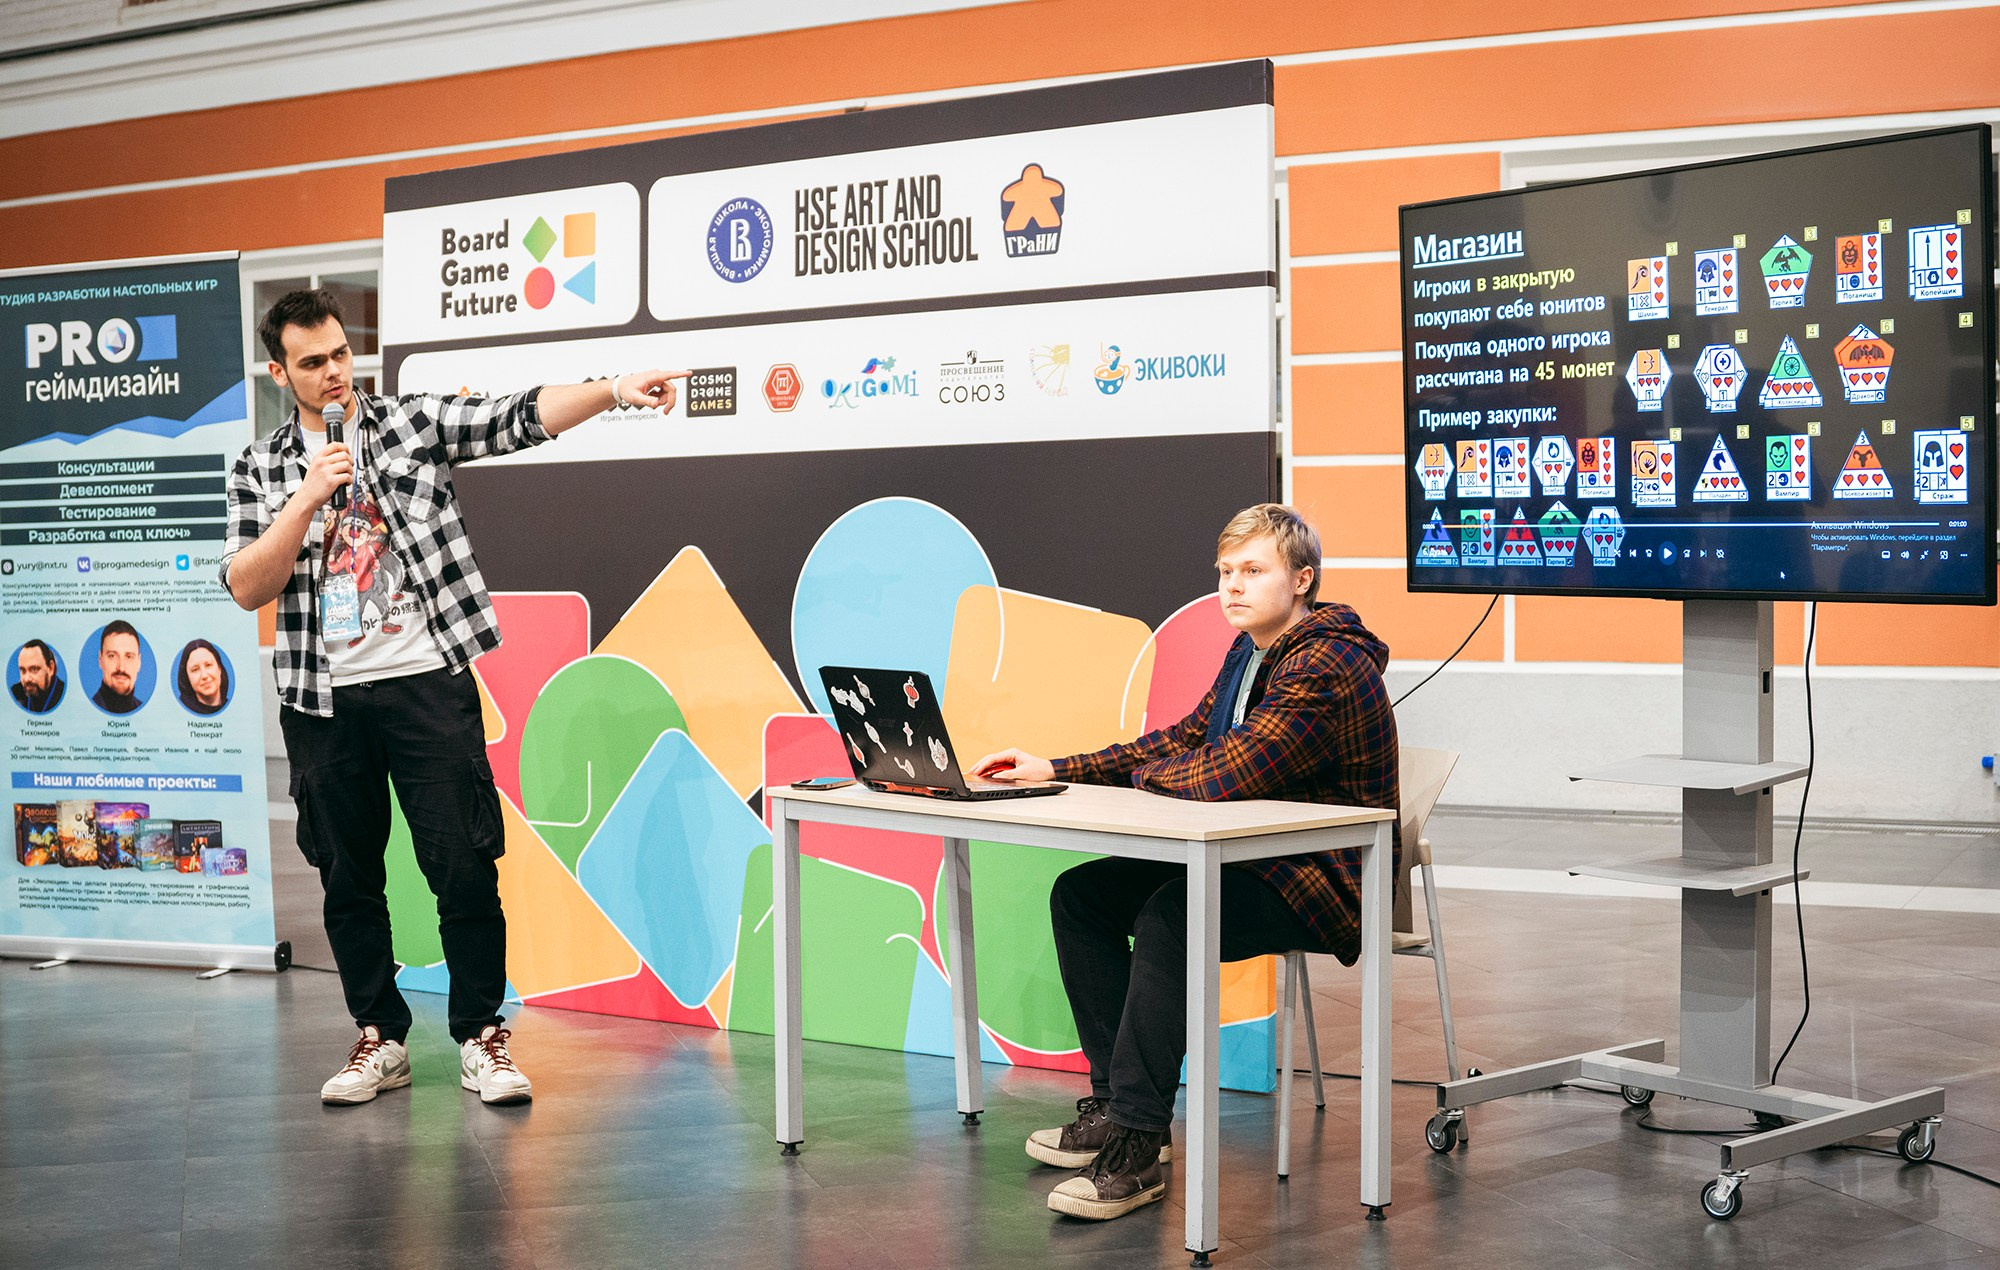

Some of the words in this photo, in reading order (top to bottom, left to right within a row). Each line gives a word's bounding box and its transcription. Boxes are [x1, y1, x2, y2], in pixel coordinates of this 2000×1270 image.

[795, 185, 839, 233] HSE
[843, 179, 889, 228] ART
[893, 173, 941, 223] AND
[714, 200, 749, 227] ШКОЛА
[441, 218, 510, 256] Board
[795, 226, 877, 277] DESIGN
[883, 216, 979, 269] SCHOOL
[1413, 230, 1524, 266] Магазин
[440, 258, 510, 287] Game
[38, 287, 110, 303] РАЗРАБОТКИ
[113, 280, 193, 297] НАСТОЛЬНЫХ
[195, 279, 218, 291] ИГР
[1413, 279, 1471, 301] Игроки
[1476, 277, 1487, 292] в
[1492, 267, 1575, 293] закрытую
[1843, 291, 1877, 300] Поганище
[1920, 287, 1958, 298] Копейщик
[440, 291, 518, 319] Future
[1414, 306, 1491, 330] покупают
[1496, 298, 1534, 320] себе
[1539, 295, 1606, 316] юнитов
[1704, 304, 1729, 313] Генерал
[1637, 311, 1658, 319] Шаман
[25, 317, 135, 369] PRO
[1415, 340, 1482, 363] Покупка
[1487, 336, 1546, 357] одного
[1551, 330, 1611, 353] игрока
[940, 365, 1005, 377] ПРОСВЕЩЕНИЕ
[1134, 353, 1226, 382] ЭКИВОКИ
[26, 366, 180, 402] геймдизайн
[690, 373, 733, 387] COSMO
[1415, 367, 1504, 393] рассчитана
[1509, 367, 1530, 383] на
[1535, 361, 1556, 380] 45
[1561, 360, 1616, 379] монет
[939, 383, 1005, 404] СОЮЗ
[1851, 391, 1875, 400] Дракон
[690, 398, 732, 412] GAMES
[1418, 408, 1482, 432] Пример
[1487, 406, 1557, 429] закупки:
[58, 460, 155, 476] Консультации
[60, 483, 154, 499] Девелопмент
[1775, 490, 1800, 499] Вампир
[1932, 491, 1955, 501] Страж
[59, 506, 157, 521] Тестирование
[29, 526, 106, 545] Разработка
[109, 529, 143, 542] «под
[146, 527, 191, 540] ключ»
[1811, 533, 1829, 541] Чтобы
[1830, 534, 1869, 542] активировать
[1898, 533, 1929, 542] перейдите
[1935, 534, 1957, 542] раздел
[16, 561, 68, 572] yury@nxt.ru
[93, 559, 170, 571] @progamedesign
[27, 719, 53, 729] Герман
[107, 719, 130, 730] Юрий
[187, 720, 223, 729] Надежда
[21, 729, 60, 738] Тихомиров
[101, 730, 137, 740] Ямщиков
[190, 731, 223, 740] Пенкрат
[34, 773, 72, 787] Наши
[75, 774, 144, 788] любимые
[148, 776, 217, 791] проекты:
